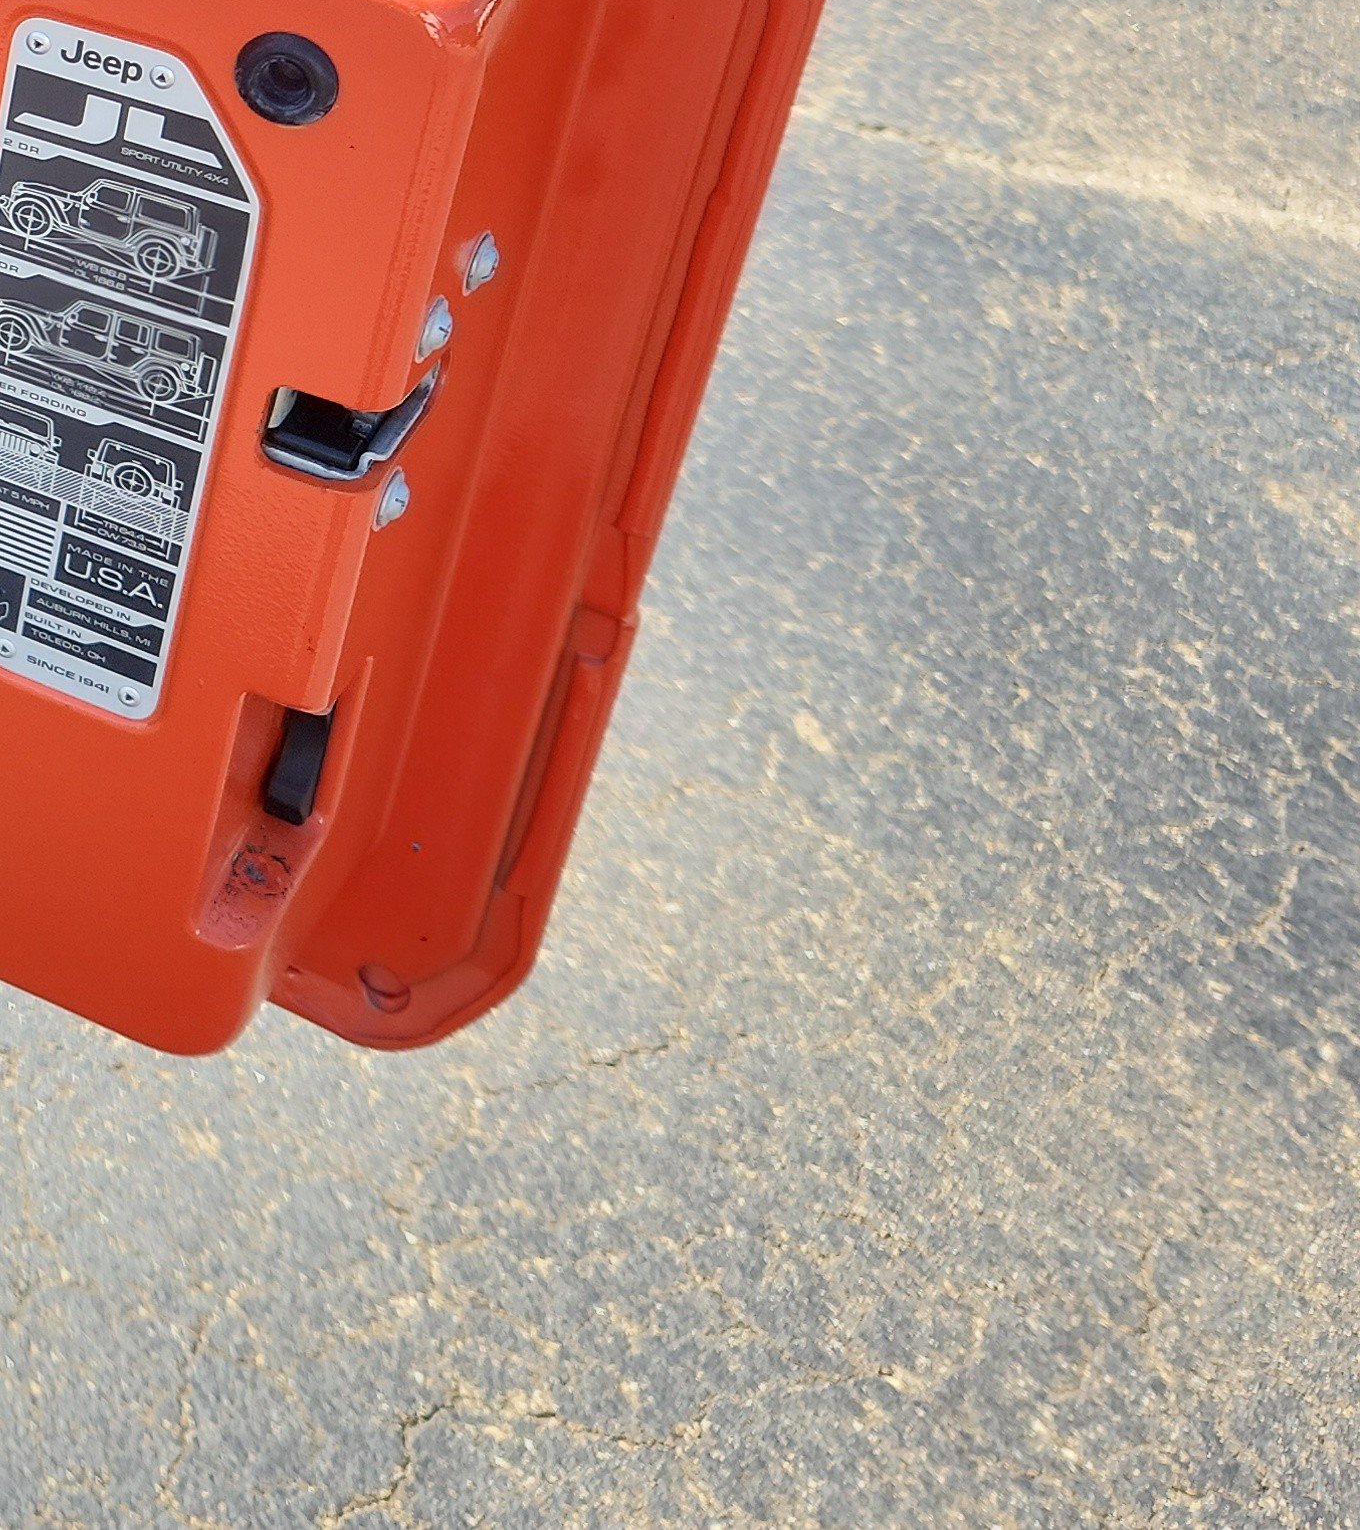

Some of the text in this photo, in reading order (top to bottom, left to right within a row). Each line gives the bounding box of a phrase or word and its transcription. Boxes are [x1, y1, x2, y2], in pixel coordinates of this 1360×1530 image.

[60, 40, 143, 83] Jeep
[3, 137, 40, 155] 2 DR
[13, 93, 223, 169] JL
[120, 146, 229, 186] SPORT UTILITY 4X4
[20, 389, 87, 418] FORDING
[11, 490, 20, 500] 5
[21, 494, 50, 511] MPH
[97, 527, 120, 540] OW
[64, 553, 163, 609] U.S.A.
[67, 543, 169, 587] MADE IN THE
[30, 577, 131, 622] DEVELOPED IN
[24, 611, 82, 639] BUILT IN
[36, 597, 152, 647] AUBURN HILLS, MI
[30, 627, 106, 663] TOLEDO, OH
[26, 654, 110, 694] SINCE 1941
